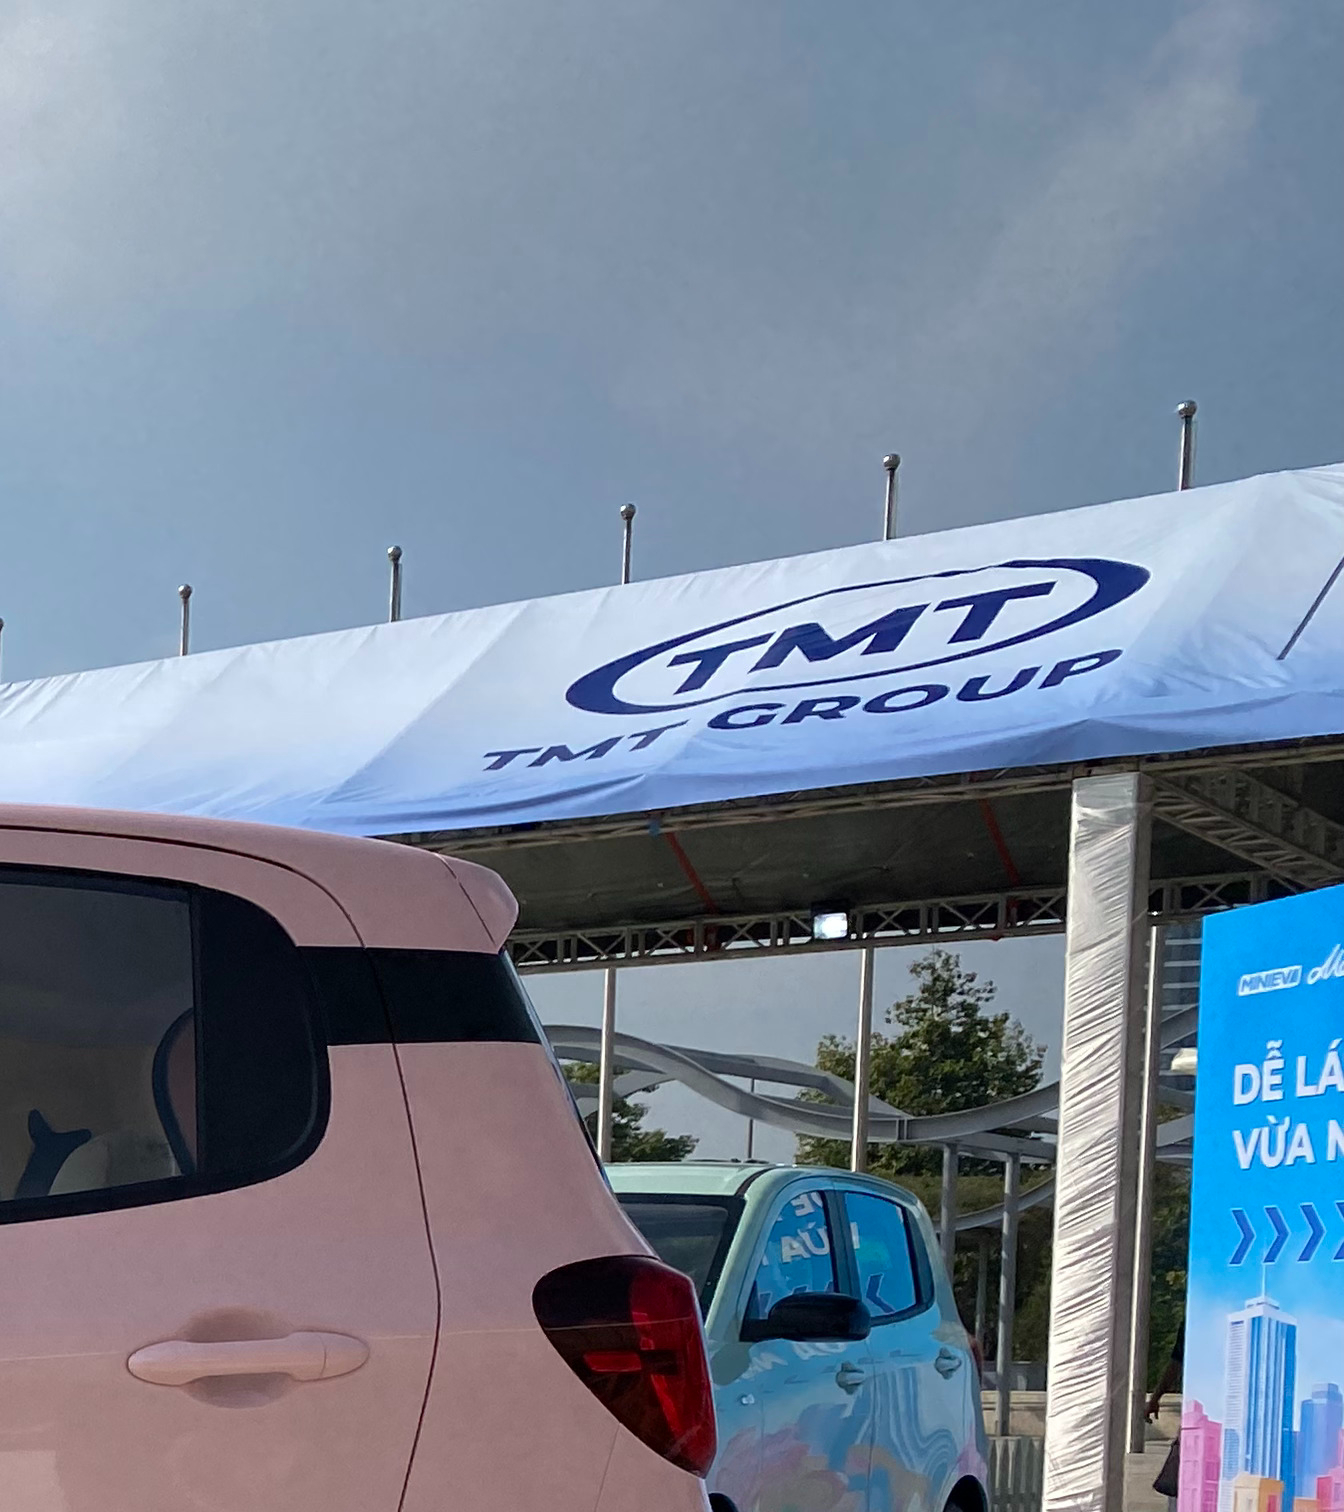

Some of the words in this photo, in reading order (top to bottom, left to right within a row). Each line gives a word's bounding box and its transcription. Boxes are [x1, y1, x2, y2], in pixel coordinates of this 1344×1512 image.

[666, 580, 1059, 695] TMT
[482, 719, 690, 771] TMT
[706, 648, 1124, 730] GROUP
[1232, 1038, 1286, 1106] DỄ
[1232, 1114, 1317, 1170] VỪA
